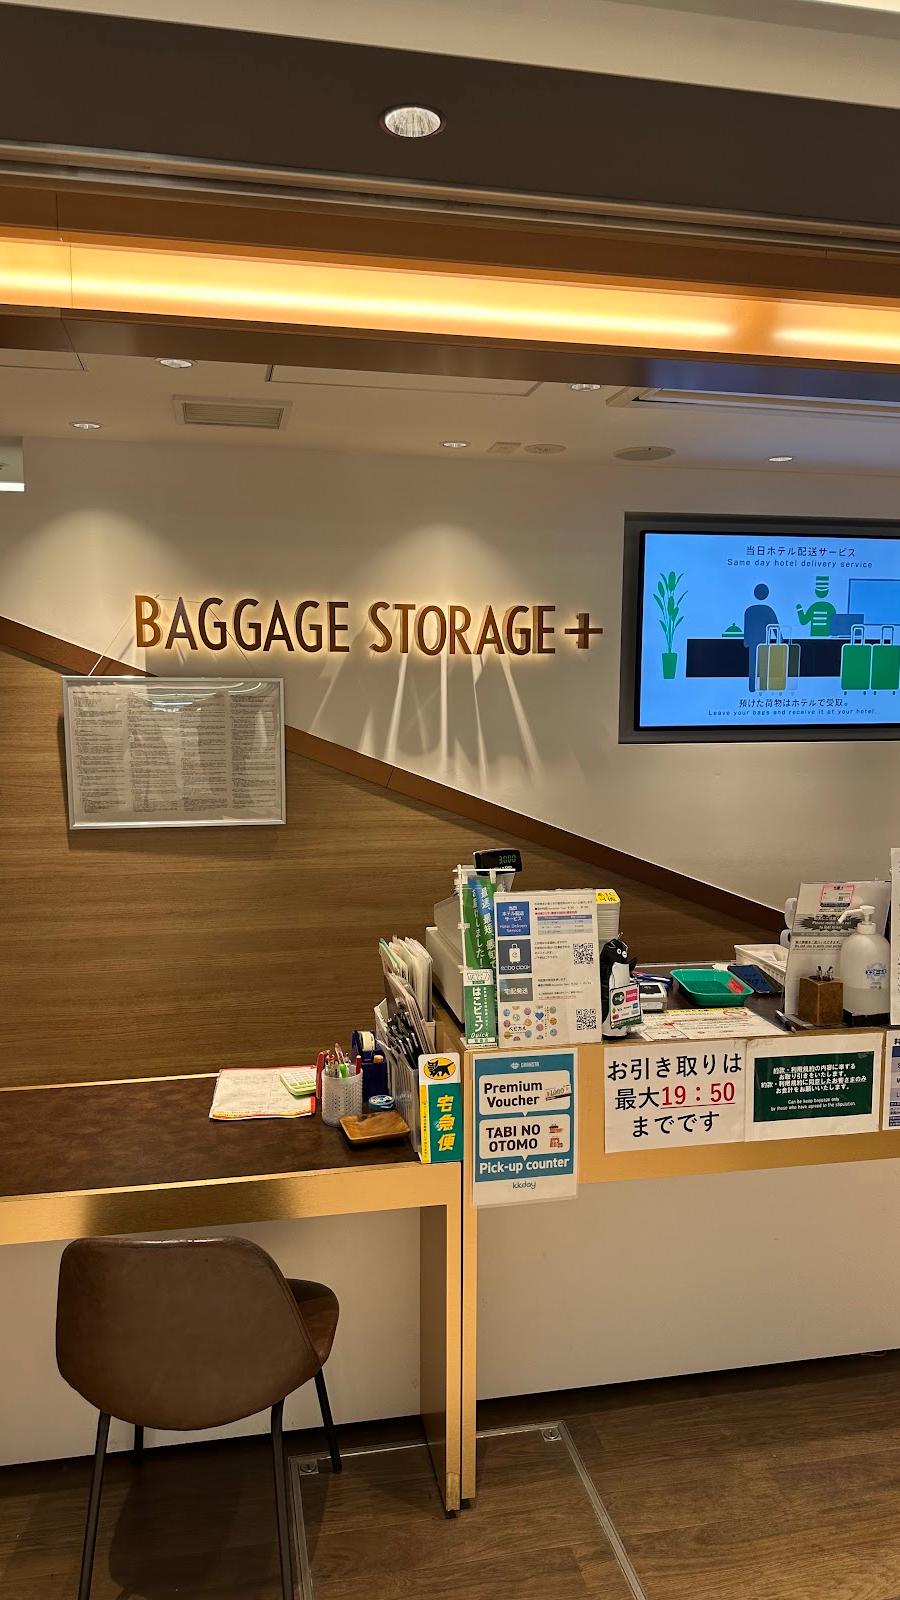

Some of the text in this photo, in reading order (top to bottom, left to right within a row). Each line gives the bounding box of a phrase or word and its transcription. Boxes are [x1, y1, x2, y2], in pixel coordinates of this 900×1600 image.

[746, 545, 856, 557] 当日ホテル配送サービス
[727, 558, 873, 569] Same day hotel delivery service
[135, 594, 350, 652] BAGGAGE
[368, 601, 556, 655] STORAGE
[772, 708, 786, 716] and
[788, 708, 815, 716] receive
[817, 708, 824, 716] it
[827, 708, 835, 716] at
[837, 709, 855, 717] your
[607, 1053, 742, 1081] お引き取りは
[483, 1080, 543, 1095] Premium
[486, 1095, 540, 1108] Voucher
[436, 1094, 457, 1152] 宅急便
[632, 1111, 720, 1138] までです
[486, 1124, 541, 1139] TABI NO
[488, 1138, 538, 1152] OTOMO
[479, 1157, 570, 1174] Pick-up counter
[512, 1181, 536, 1190] kkday
